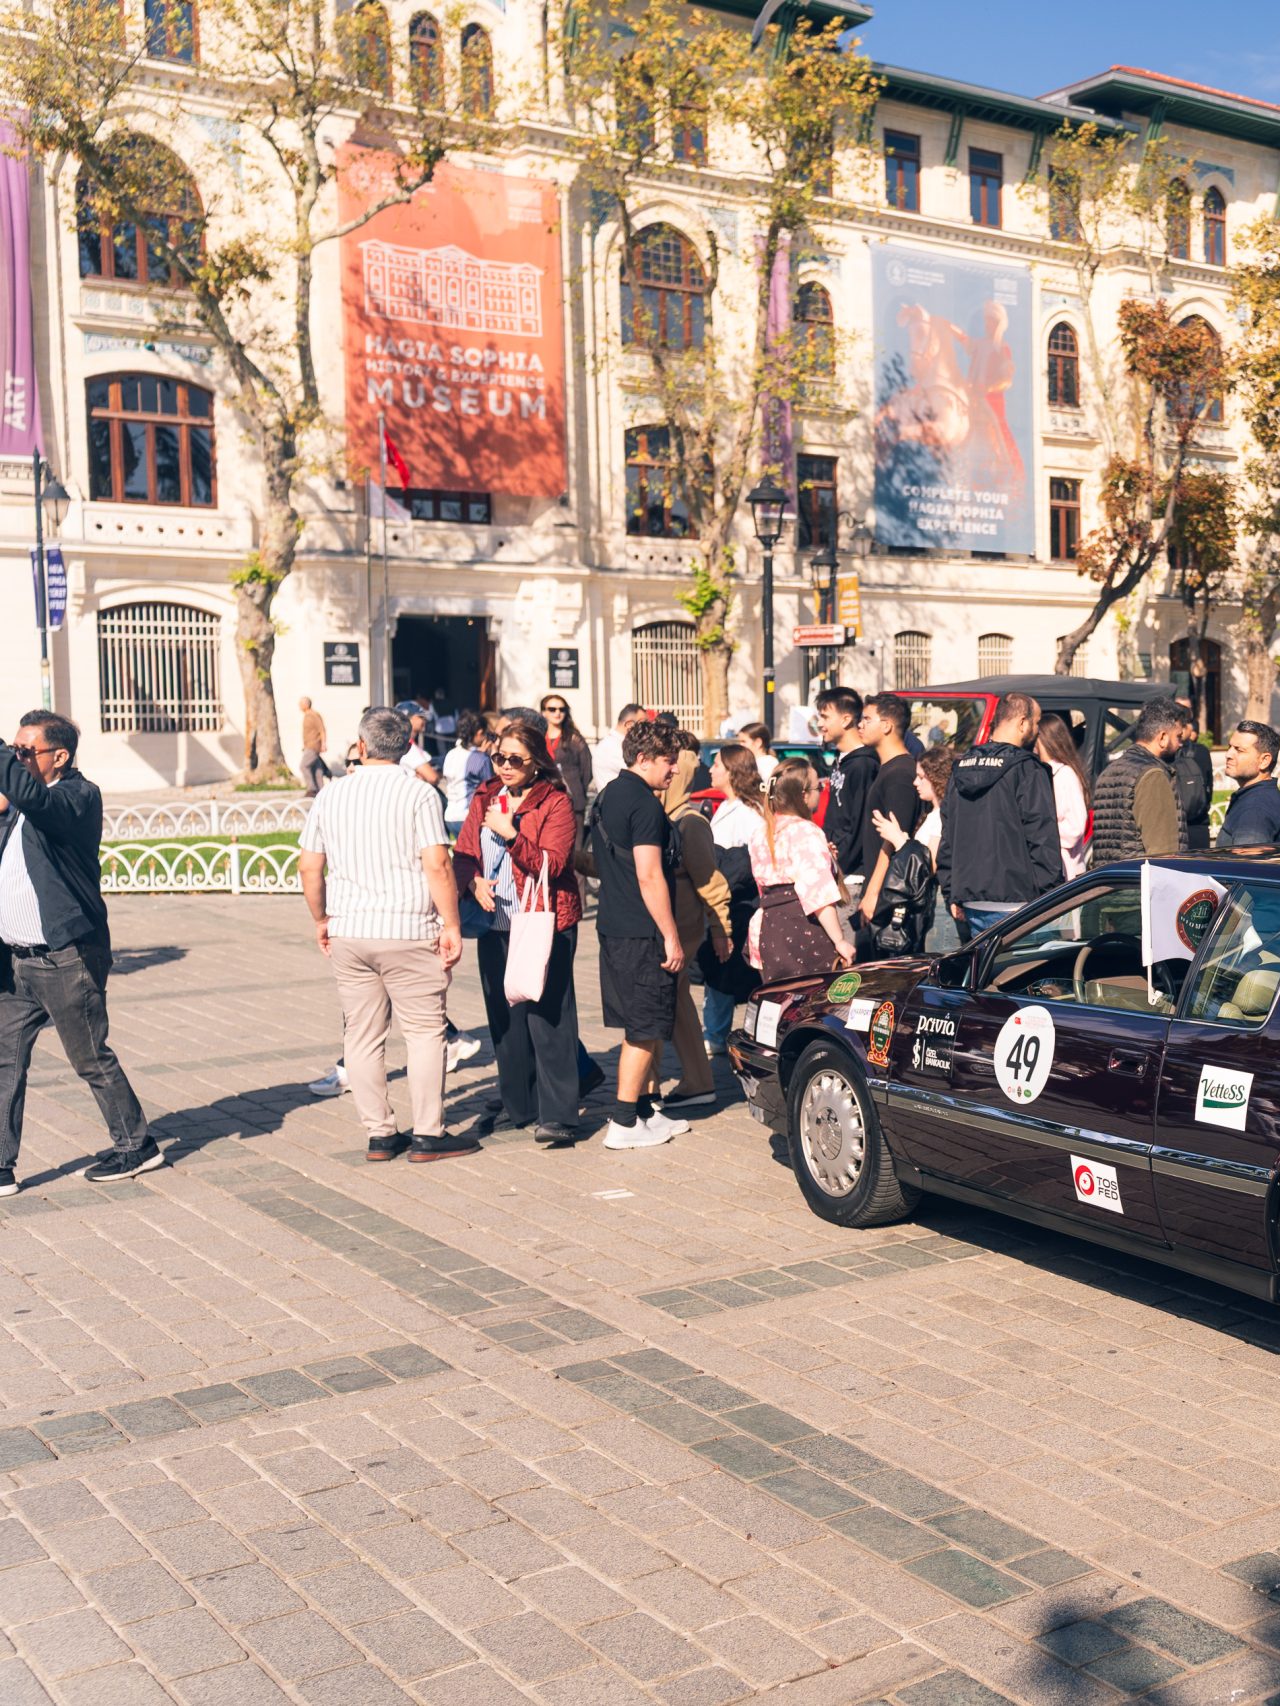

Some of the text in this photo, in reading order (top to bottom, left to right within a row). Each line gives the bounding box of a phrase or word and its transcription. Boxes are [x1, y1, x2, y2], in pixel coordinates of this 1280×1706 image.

[365, 334, 544, 372] HAGIA SOPHIA
[366, 359, 545, 389] HISTORY & EXPERIENCE
[4, 369, 26, 432] ART
[367, 378, 546, 420] MUSEUM
[903, 485, 1009, 505] COMPLETE YOUR
[909, 501, 1004, 520] HAGIA SOPHIA
[917, 518, 998, 535] EXPERIENCE
[916, 1013, 955, 1036] privia
[1006, 1033, 1040, 1083] 49
[1201, 1078, 1245, 1101] VetteSS
[1096, 1175, 1118, 1190] TOS
[1098, 1187, 1119, 1201] FED
